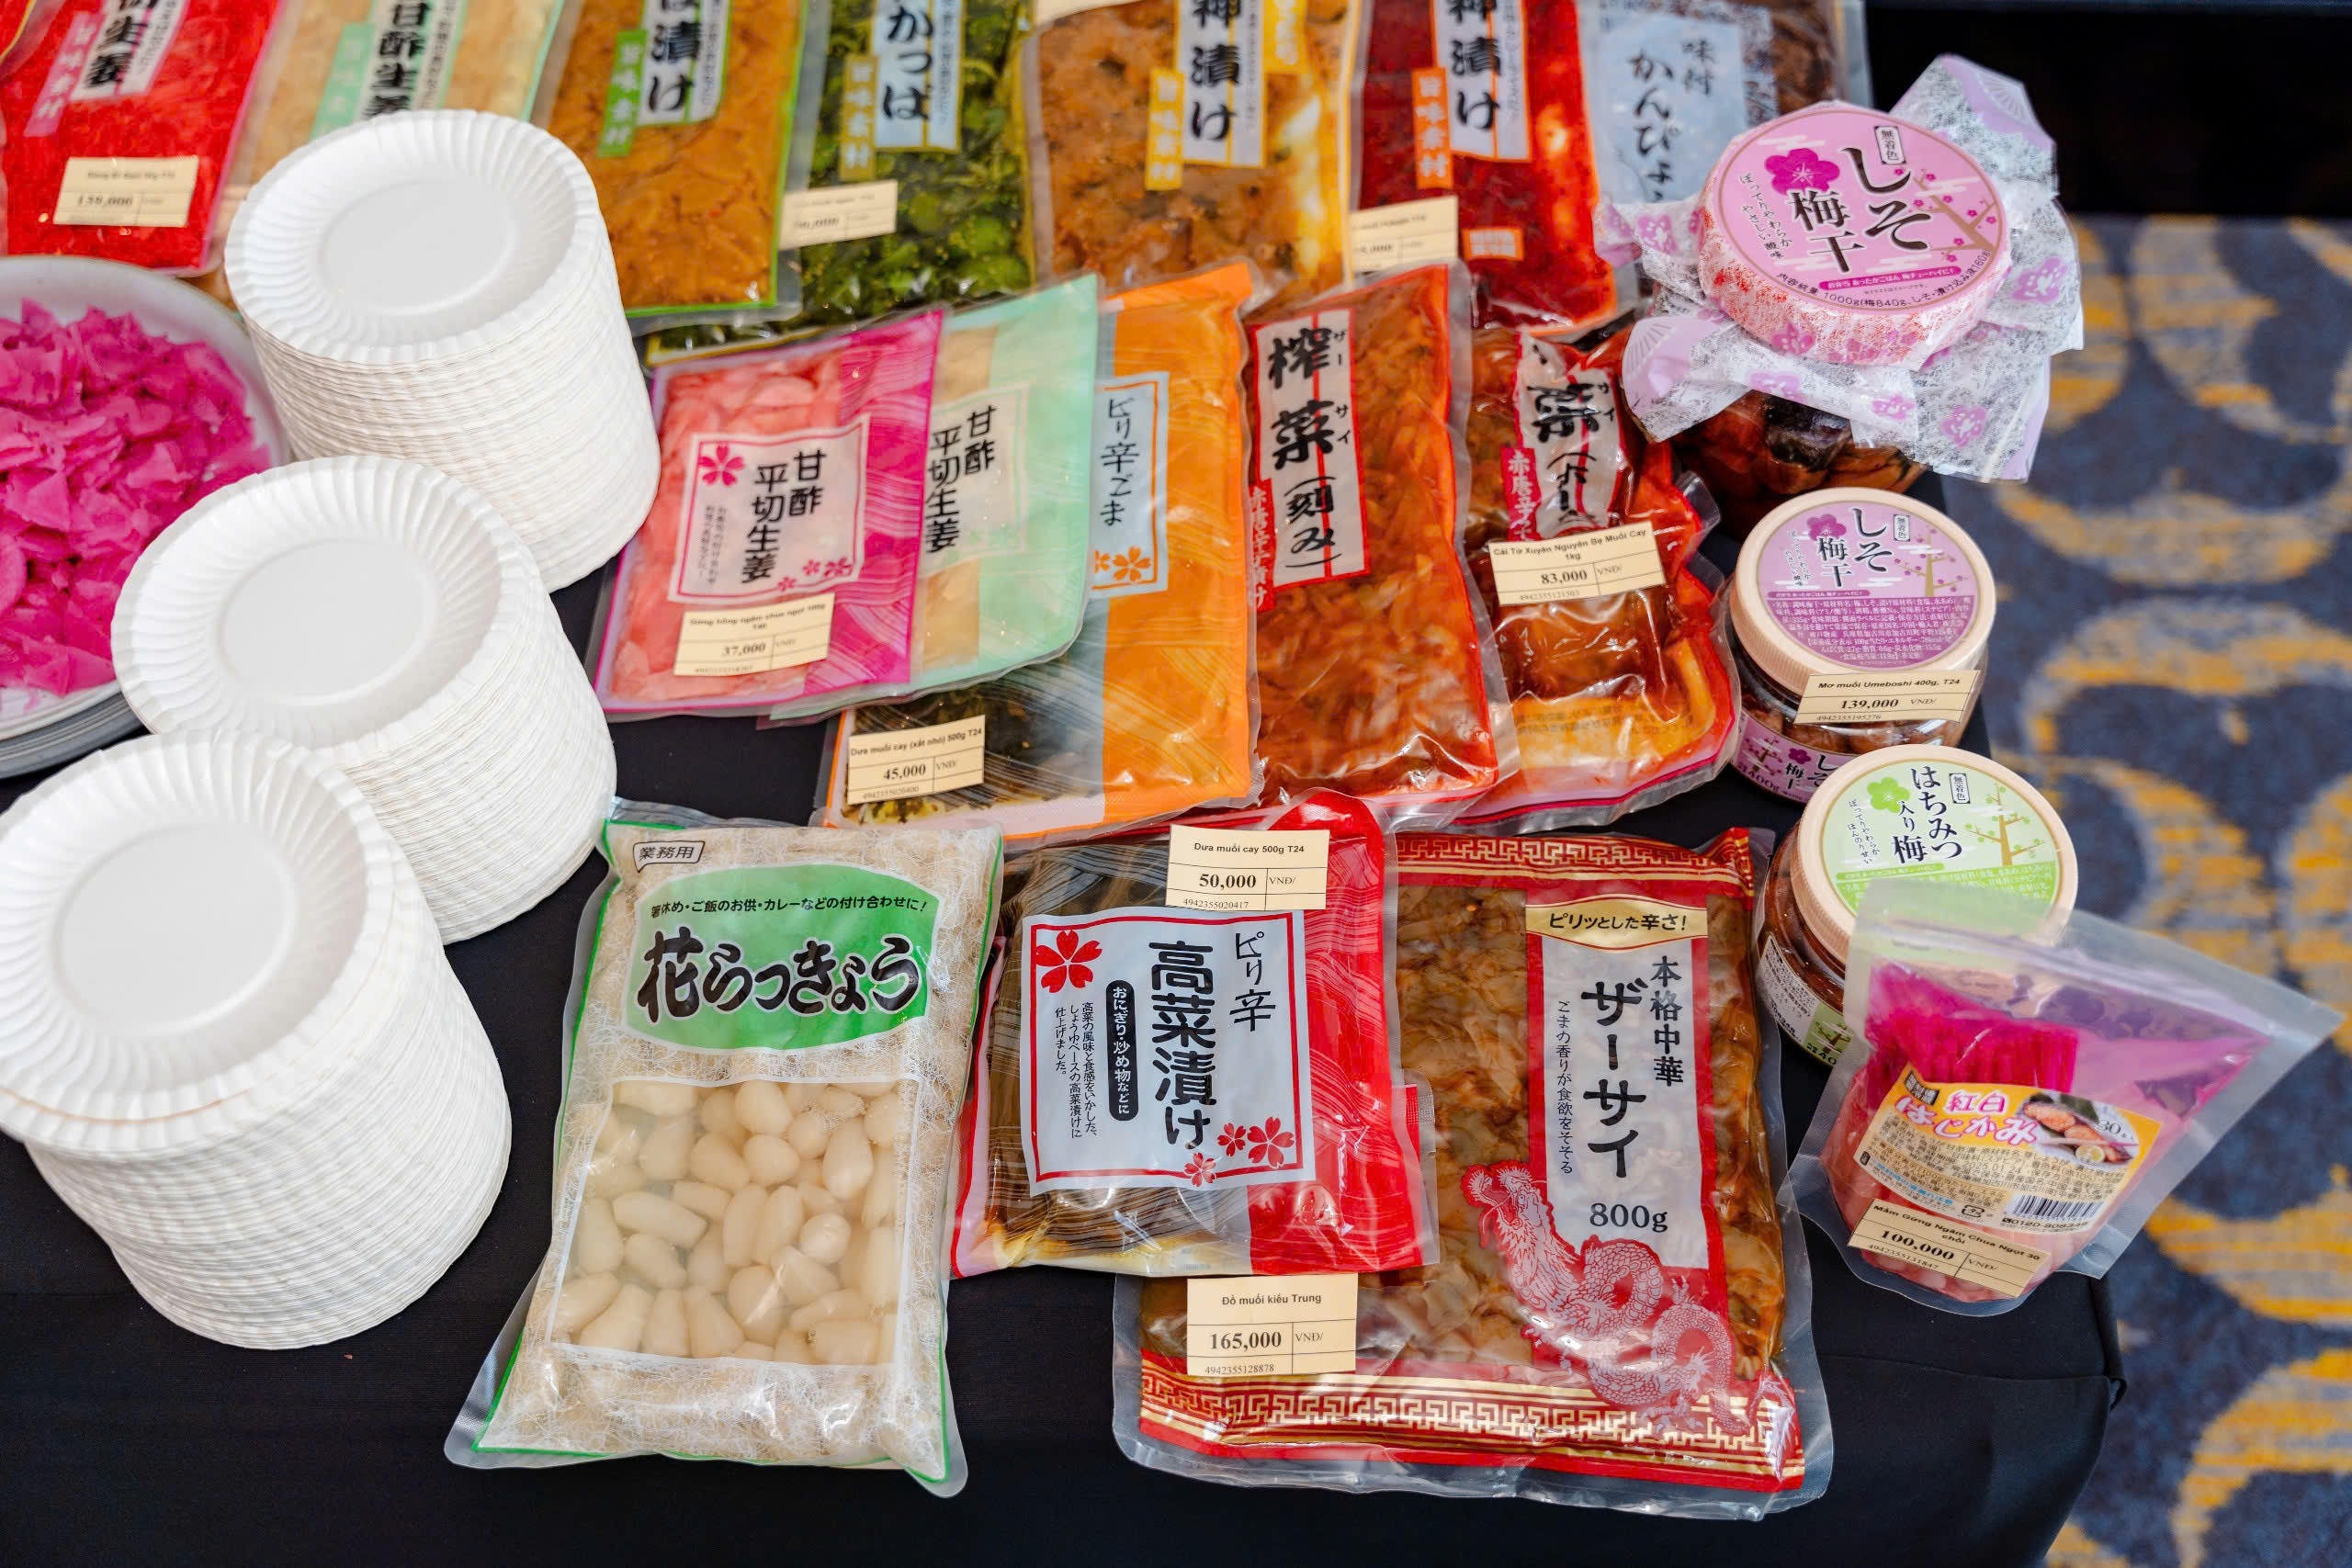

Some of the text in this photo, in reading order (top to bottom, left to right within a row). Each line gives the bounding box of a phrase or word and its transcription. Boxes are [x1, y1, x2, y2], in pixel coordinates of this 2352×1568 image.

[649, 0, 704, 113] 漬け
[1841, 147, 1931, 251] しそ
[1788, 190, 1865, 273] 梅干
[965, 405, 997, 475] 甘酢
[789, 449, 827, 517] 甘酢
[925, 425, 962, 553] 平切生姜
[742, 463, 788, 583] 平切生姜
[1629, 529, 1647, 539] Cay
[1852, 508, 1893, 572] しそ
[1541, 570, 1588, 586] 83,000
[1817, 537, 1853, 587] 梅干
[1840, 698, 1899, 710] 139,000
[1863, 680, 1913, 689] Umeboshi
[893, 742, 907, 752] cay
[947, 731, 967, 742] 500g
[968, 728, 982, 738] T24
[883, 763, 926, 781] 45,000
[1953, 775, 1966, 802] 無着色
[1911, 766, 1962, 859] はちみつ
[639, 846, 695, 862] 業務用
[1194, 842, 1214, 852] Dưa
[1243, 846, 1260, 854] cay
[1261, 845, 1284, 854] 500g
[1288, 844, 1305, 852] T24
[1182, 897, 1250, 909] 4942355020417
[1199, 874, 1296, 890] 50,000 VNĐ/
[1550, 913, 1687, 931] ピリッとした辛さ!
[637, 926, 920, 1023] 花らっきょう
[1056, 1007, 1067, 1075] 仕上げました。
[1148, 940, 1216, 1150] 高菜漬け
[1650, 955, 1684, 1087] 本格中華
[1069, 1005, 1082, 1139] しょうゆベースの高菜漬けに
[1082, 1001, 1097, 1136] 高菜の風味と食感をいかした、
[1113, 987, 1133, 1115] おにぎり・炒め物などに
[1555, 1000, 1574, 1175] ごまの香りが食欲をそそる
[1581, 977, 1648, 1179] ザーサイ
[1946, 1090, 2007, 1114] 紅白
[1894, 1094, 2039, 1146] はじかみ
[1589, 1202, 1668, 1233] 800g
[1882, 1230, 1955, 1261] 100,000
[1969, 1234, 1996, 1247] Chua
[2027, 1251, 2041, 1261] 30
[1292, 1293, 1321, 1304] Trung
[1210, 1332, 1324, 1351] 165,000 VNĐ/
[1204, 1364, 1274, 1374] 4942355128878
